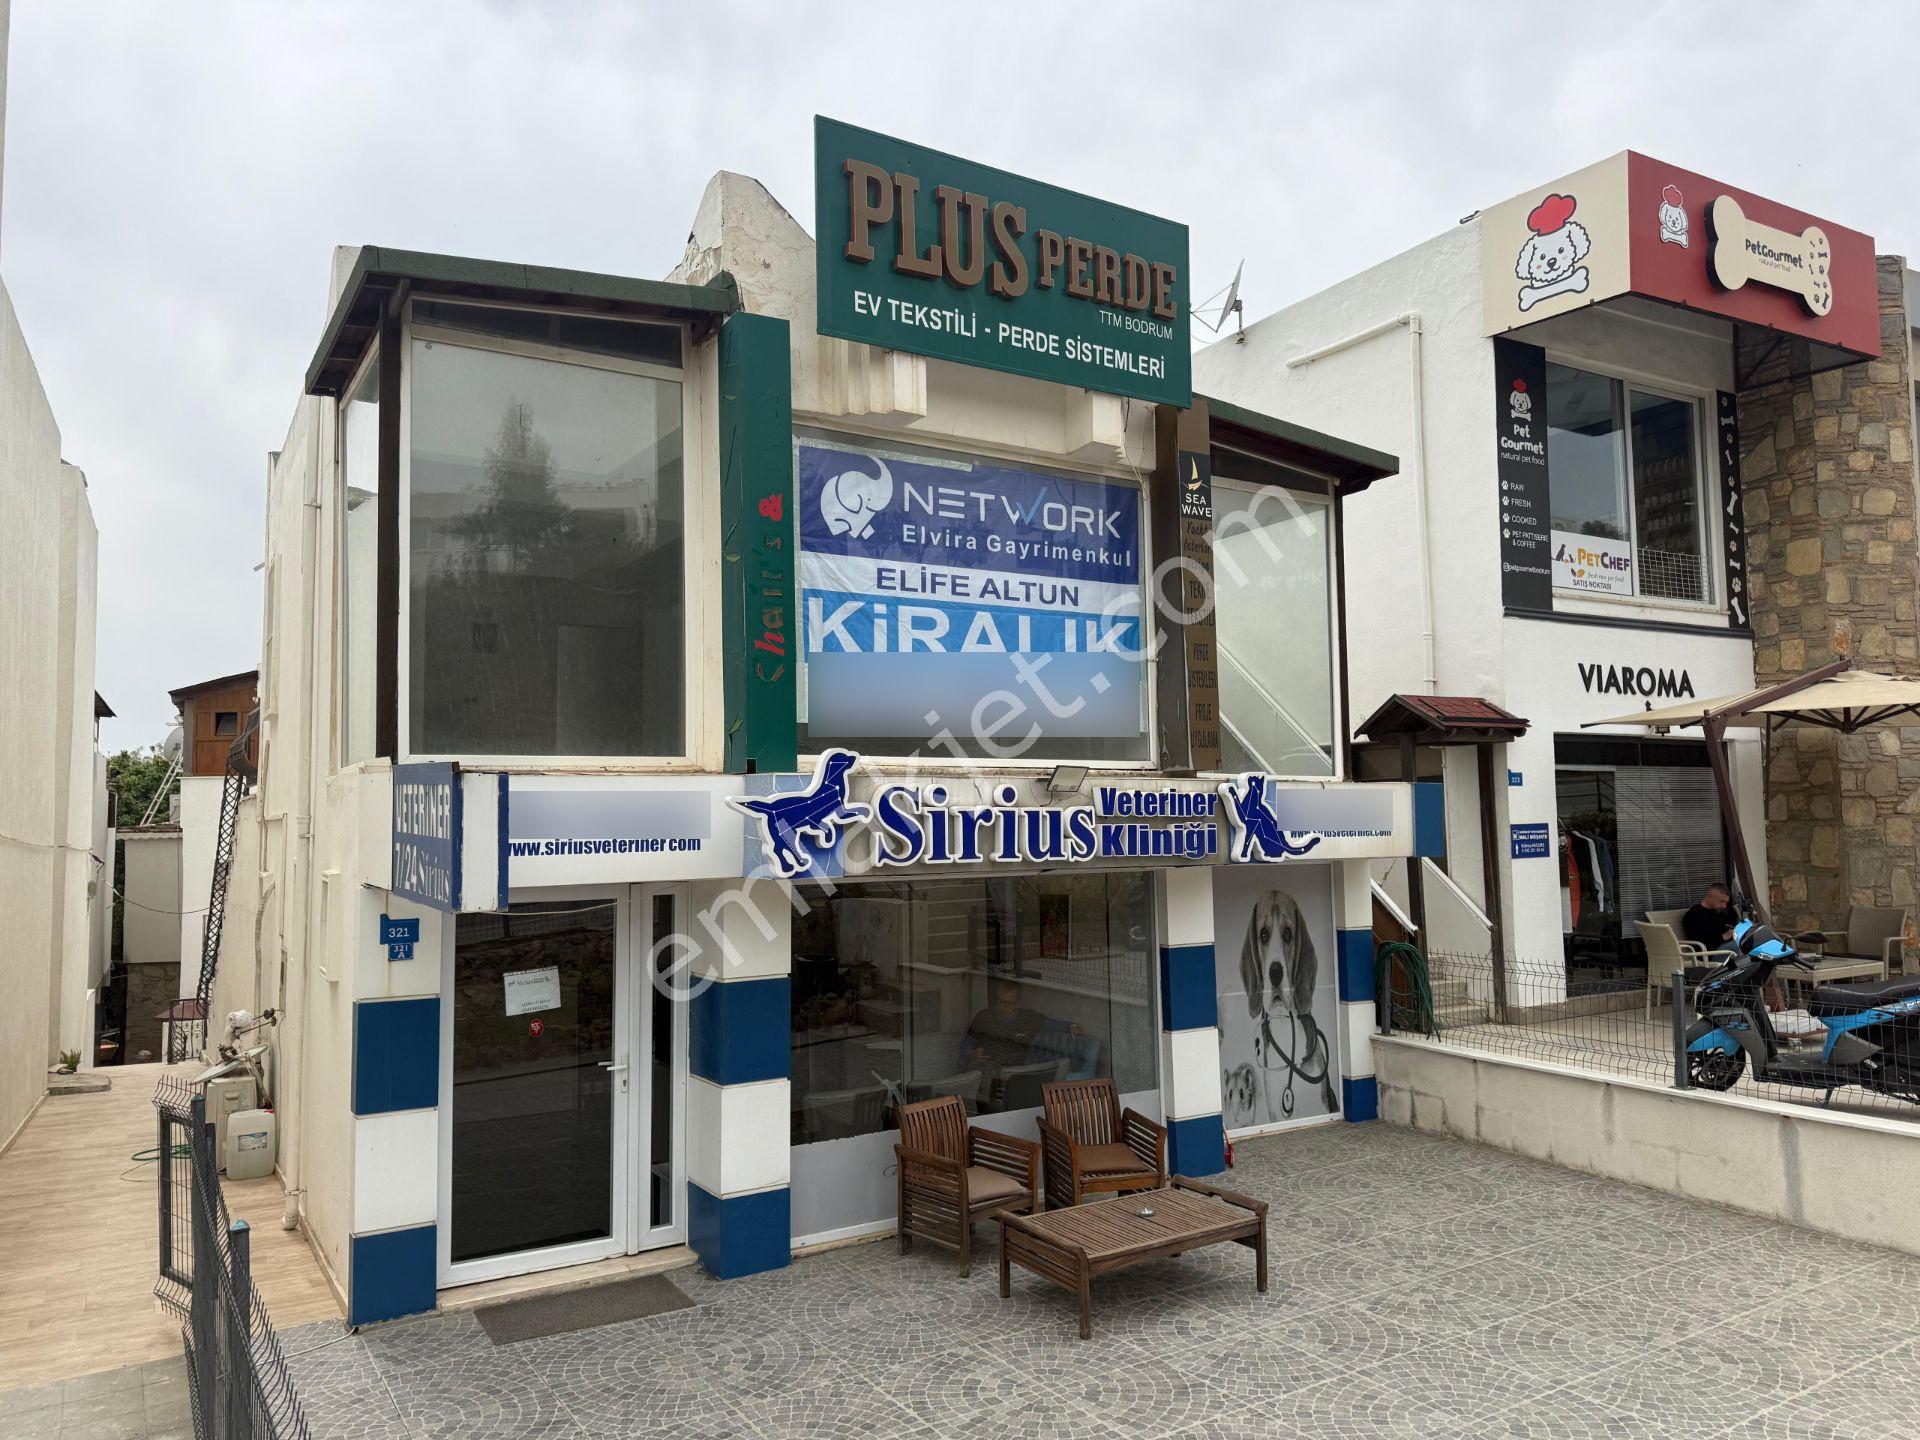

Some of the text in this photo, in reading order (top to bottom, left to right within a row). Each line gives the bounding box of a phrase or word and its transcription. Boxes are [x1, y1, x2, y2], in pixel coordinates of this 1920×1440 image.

[844, 158, 1178, 320] PLUS PERDE
[1745, 239, 1803, 269] PetGourmet
[854, 290, 882, 317] EV
[887, 298, 976, 338] TEKSTİLİ
[998, 323, 1060, 356] PERDE
[1065, 335, 1165, 379] SİSTEMLERİ
[1099, 309, 1173, 340] TTM BODRUM
[1513, 424, 1530, 438] Pet
[1500, 436, 1544, 455] Gourmet
[1501, 452, 1545, 466] natural pet food
[1510, 482, 1524, 491] RAW
[903, 482, 1122, 539] NETWORK
[1181, 503, 1212, 518] WAVE
[1185, 493, 1207, 505] SEA
[1511, 498, 1531, 508] FRESH
[1511, 515, 1537, 526] COOKED
[903, 524, 1131, 567] Elvira Gayrimenkul
[1517, 540, 1536, 549] COFFEE
[876, 566, 1079, 607] ELİFE ALTUN
[1577, 662, 1695, 698] VIAROMA
[1100, 787, 1218, 817] Veteriner
[873, 784, 1098, 867] Sirius
[1101, 823, 1217, 860] Kliniği
[395, 841, 450, 903] 7/24 Sirius
[388, 927, 410, 938] 321
[393, 944, 408, 953] 321
[397, 951, 406, 960] A
